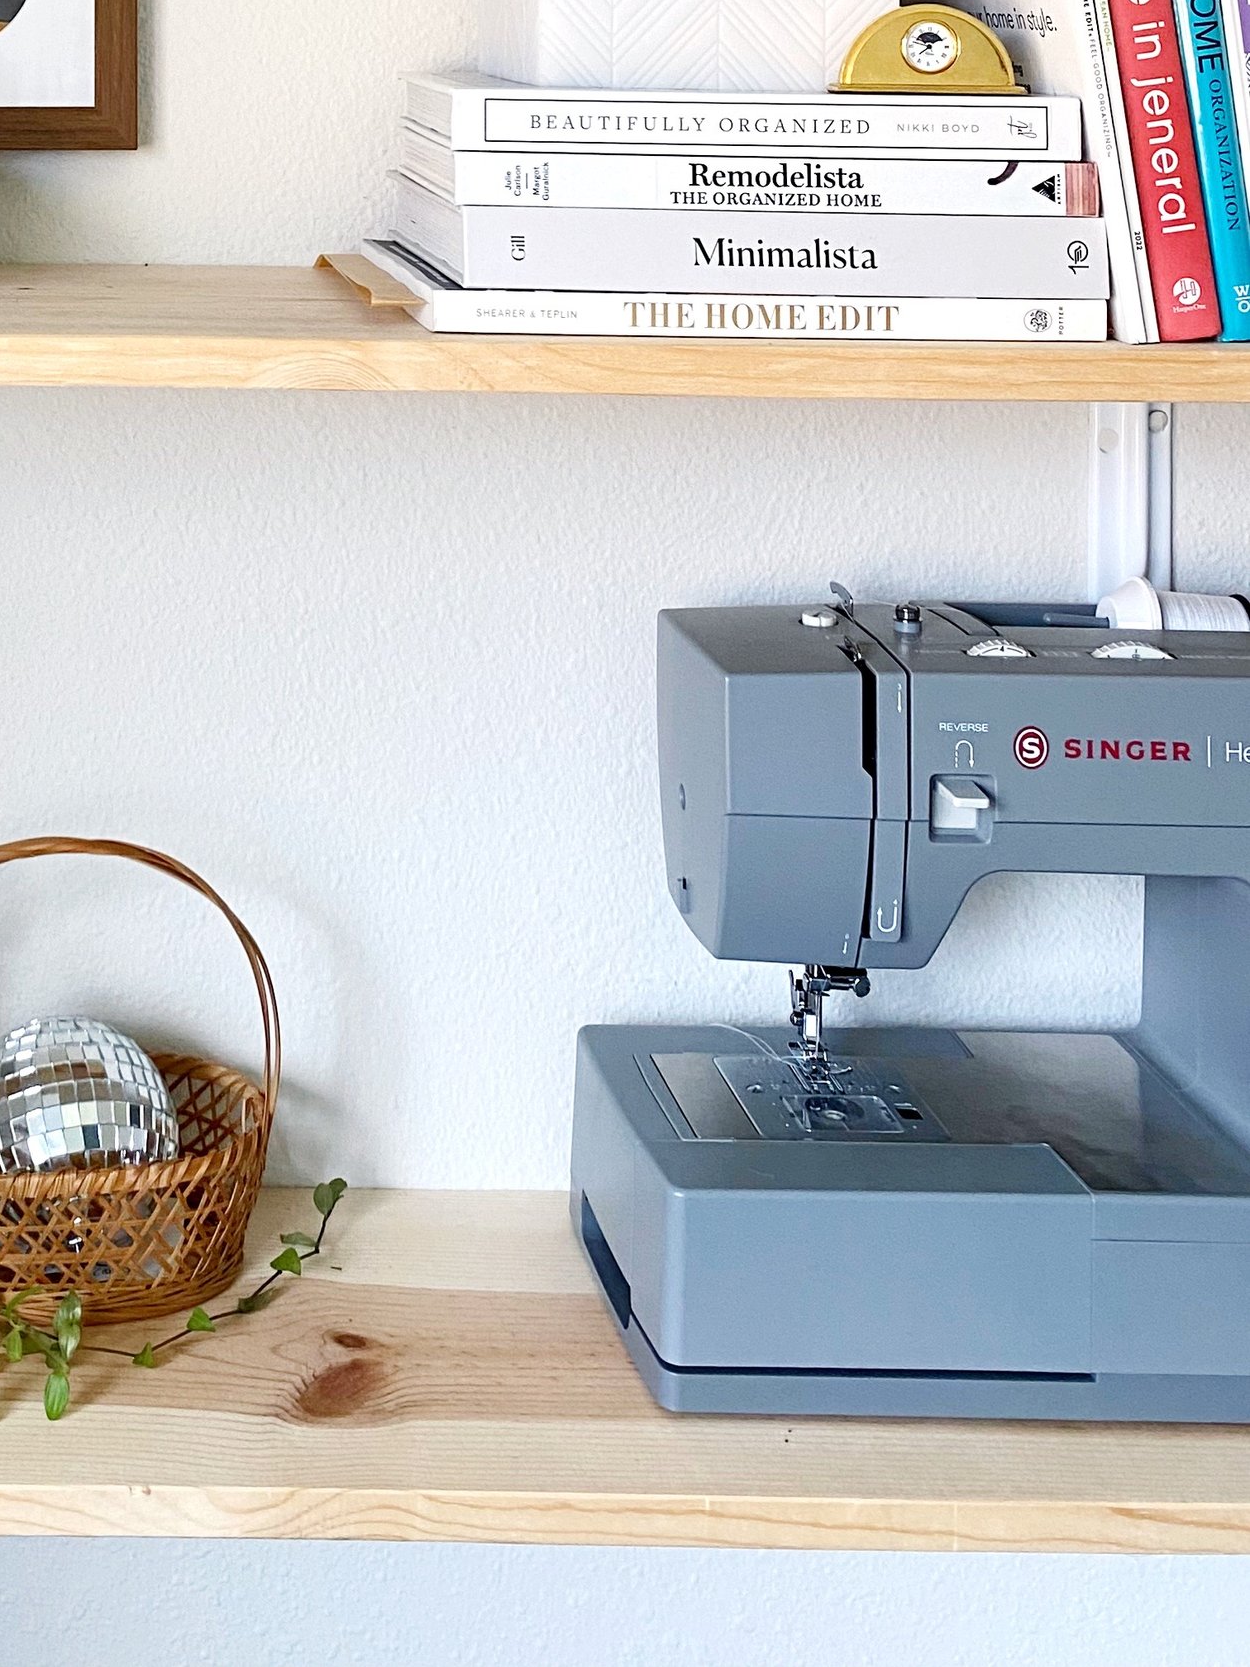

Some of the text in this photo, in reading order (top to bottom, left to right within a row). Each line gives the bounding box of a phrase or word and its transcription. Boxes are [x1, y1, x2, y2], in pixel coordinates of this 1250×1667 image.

[984, 5, 1014, 29] home
[1014, 7, 1026, 32] in
[1027, 11, 1058, 38] style.
[1132, 20, 1165, 61] in
[530, 114, 981, 134] BEAUTIFULLY ORGANIZED NIKKI BOYD
[1130, 76, 1197, 234] jeneral
[1209, 79, 1241, 232] ORGANIZATION
[504, 170, 512, 191] Julie
[514, 164, 522, 197] Carlson
[532, 166, 541, 196] Margot
[541, 161, 550, 201] Guralnick
[688, 162, 865, 189] Remodelista
[670, 191, 883, 208] THE ORGANIZED HOME
[511, 235, 526, 262] Gill
[692, 237, 879, 270] Minimalista
[1134, 230, 1143, 251] 2022
[476, 308, 578, 320] SHEARER & TEPLIN
[623, 300, 900, 332] THE HOME EDIT
[939, 722, 989, 733] REVERSE
[1064, 738, 1192, 761] SINGER
